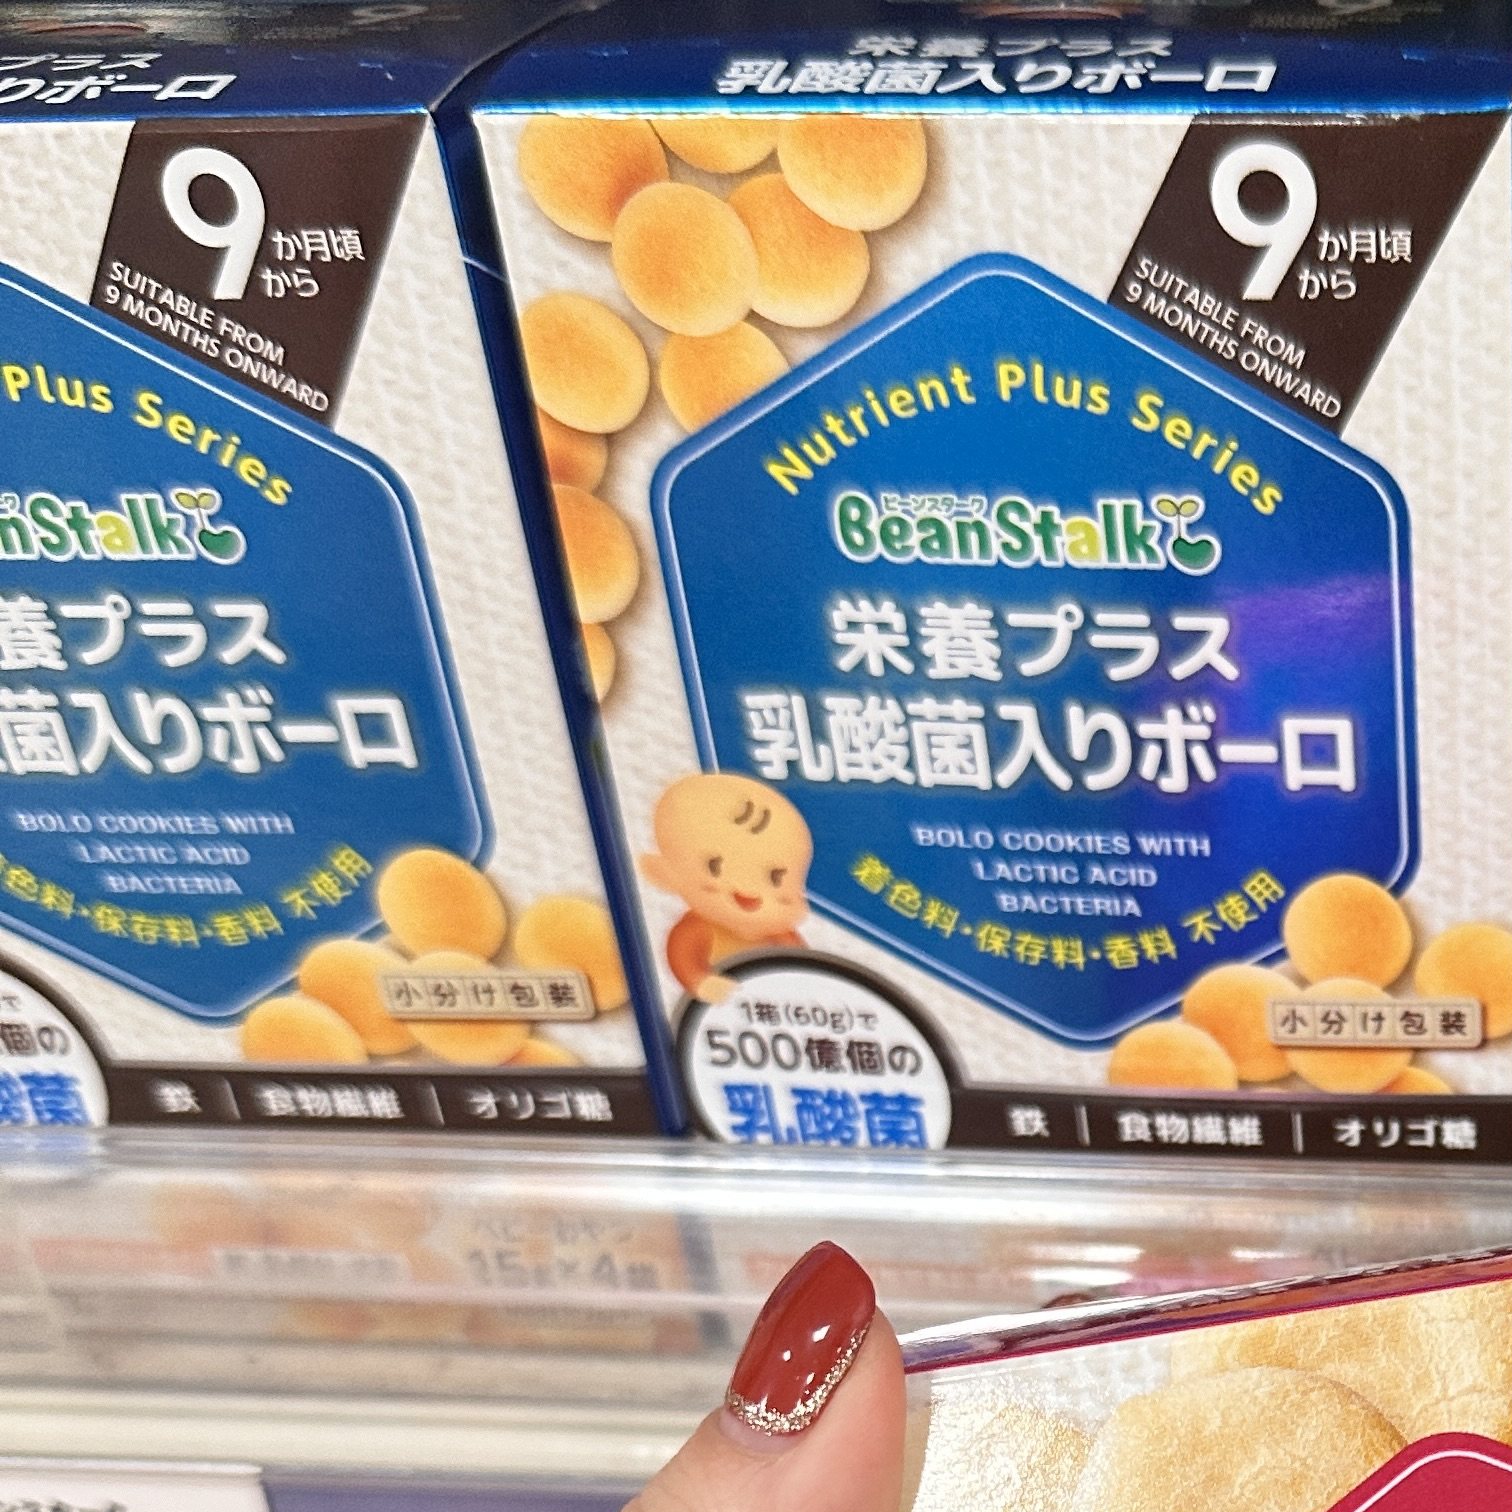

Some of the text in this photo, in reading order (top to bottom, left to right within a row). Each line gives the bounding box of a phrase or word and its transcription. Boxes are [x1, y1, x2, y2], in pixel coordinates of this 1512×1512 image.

[716, 58, 1279, 96] 乳酸菌入りボーロ
[848, 34, 1176, 58] 栄養プラス
[162, 147, 366, 301] 9 か月頃
[1211, 142, 1414, 301] 9 か月頃
[109, 261, 286, 365] SUITABLE FROM
[261, 267, 320, 299] から
[1135, 256, 1307, 370] SUITABLE FROM
[1298, 268, 1358, 301] から
[105, 285, 330, 414] 9 MONTHS ONWARD
[1125, 280, 1342, 419] 9 MONTHS ONWARD
[2, 363, 293, 507] Plus Series
[762, 362, 1284, 516] Nutrient Plus Series
[833, 490, 1168, 570] BeanStalk
[830, 597, 1241, 684] 栄養プラス
[0, 687, 419, 776] 菌入りボーロ
[742, 692, 1358, 794] 乳酸菌入りボーロ
[16, 812, 296, 835] BOLO COOKIES WITH
[77, 843, 250, 866] LACTIC ACID
[913, 825, 1212, 858] BOLO COOKIES WITH
[0, 855, 284, 948] 色料・保存料・香料
[104, 872, 243, 895] BACTERIA
[972, 859, 1158, 888] LACTIC ACID
[997, 892, 1142, 918] BACTERIA
[1182, 868, 1287, 946] 不使用
[392, 976, 581, 1009] 小分け包装
[1280, 1008, 1469, 1038] 小分け包装
[705, 1028, 923, 1077] 500億個の
[722, 1082, 929, 1149] 乳酸菌
[1116, 1110, 1265, 1148] 食物繊維
[1332, 1116, 1478, 1151] オリゴ糖
